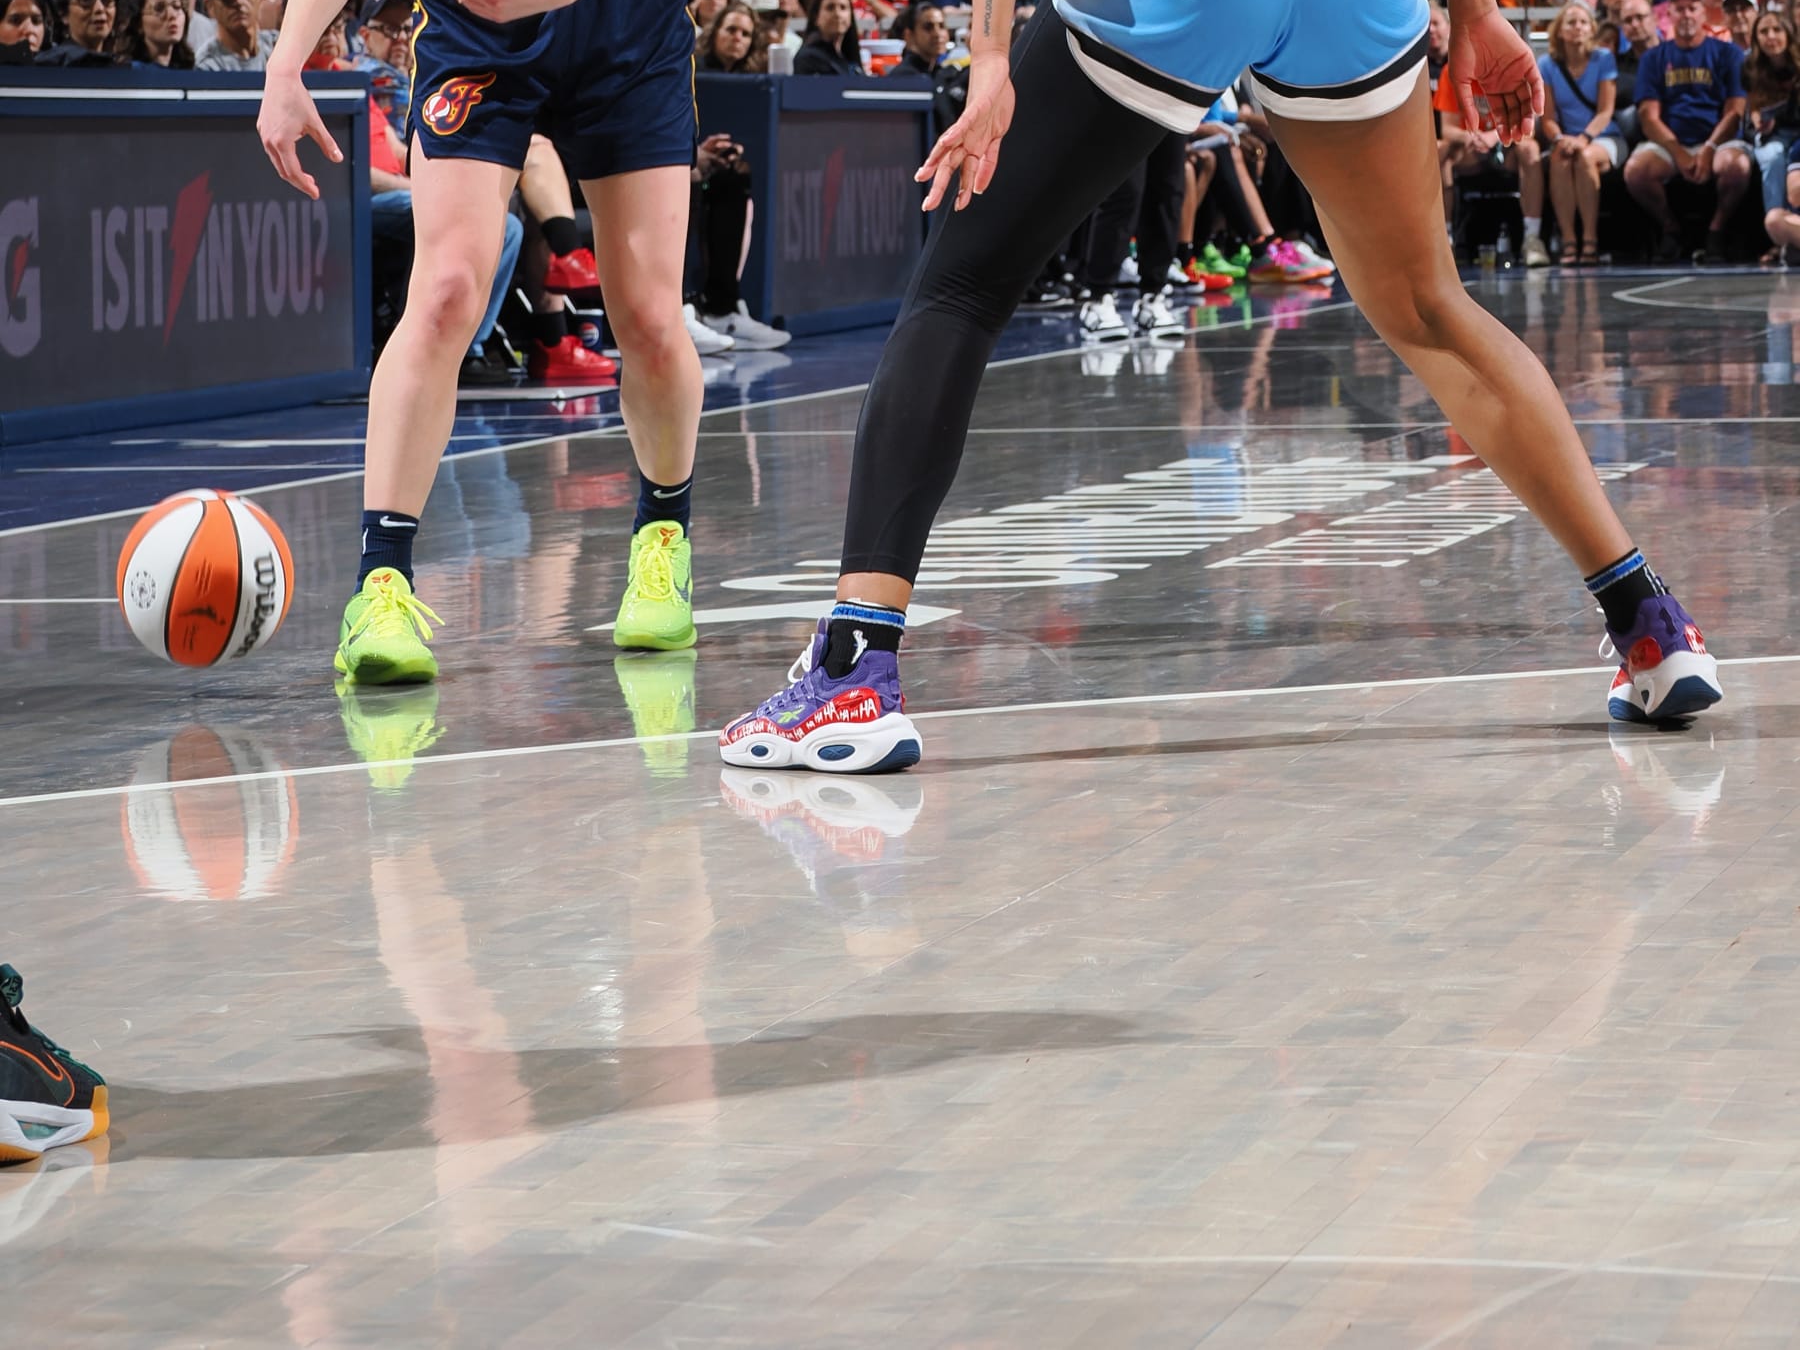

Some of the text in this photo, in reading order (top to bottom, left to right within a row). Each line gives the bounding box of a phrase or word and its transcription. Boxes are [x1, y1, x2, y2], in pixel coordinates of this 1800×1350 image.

[91, 198, 329, 332] IS IT IN YOU?
[720, 454, 1478, 592] GAINBRIDGE
[859, 697, 878, 720] HA
